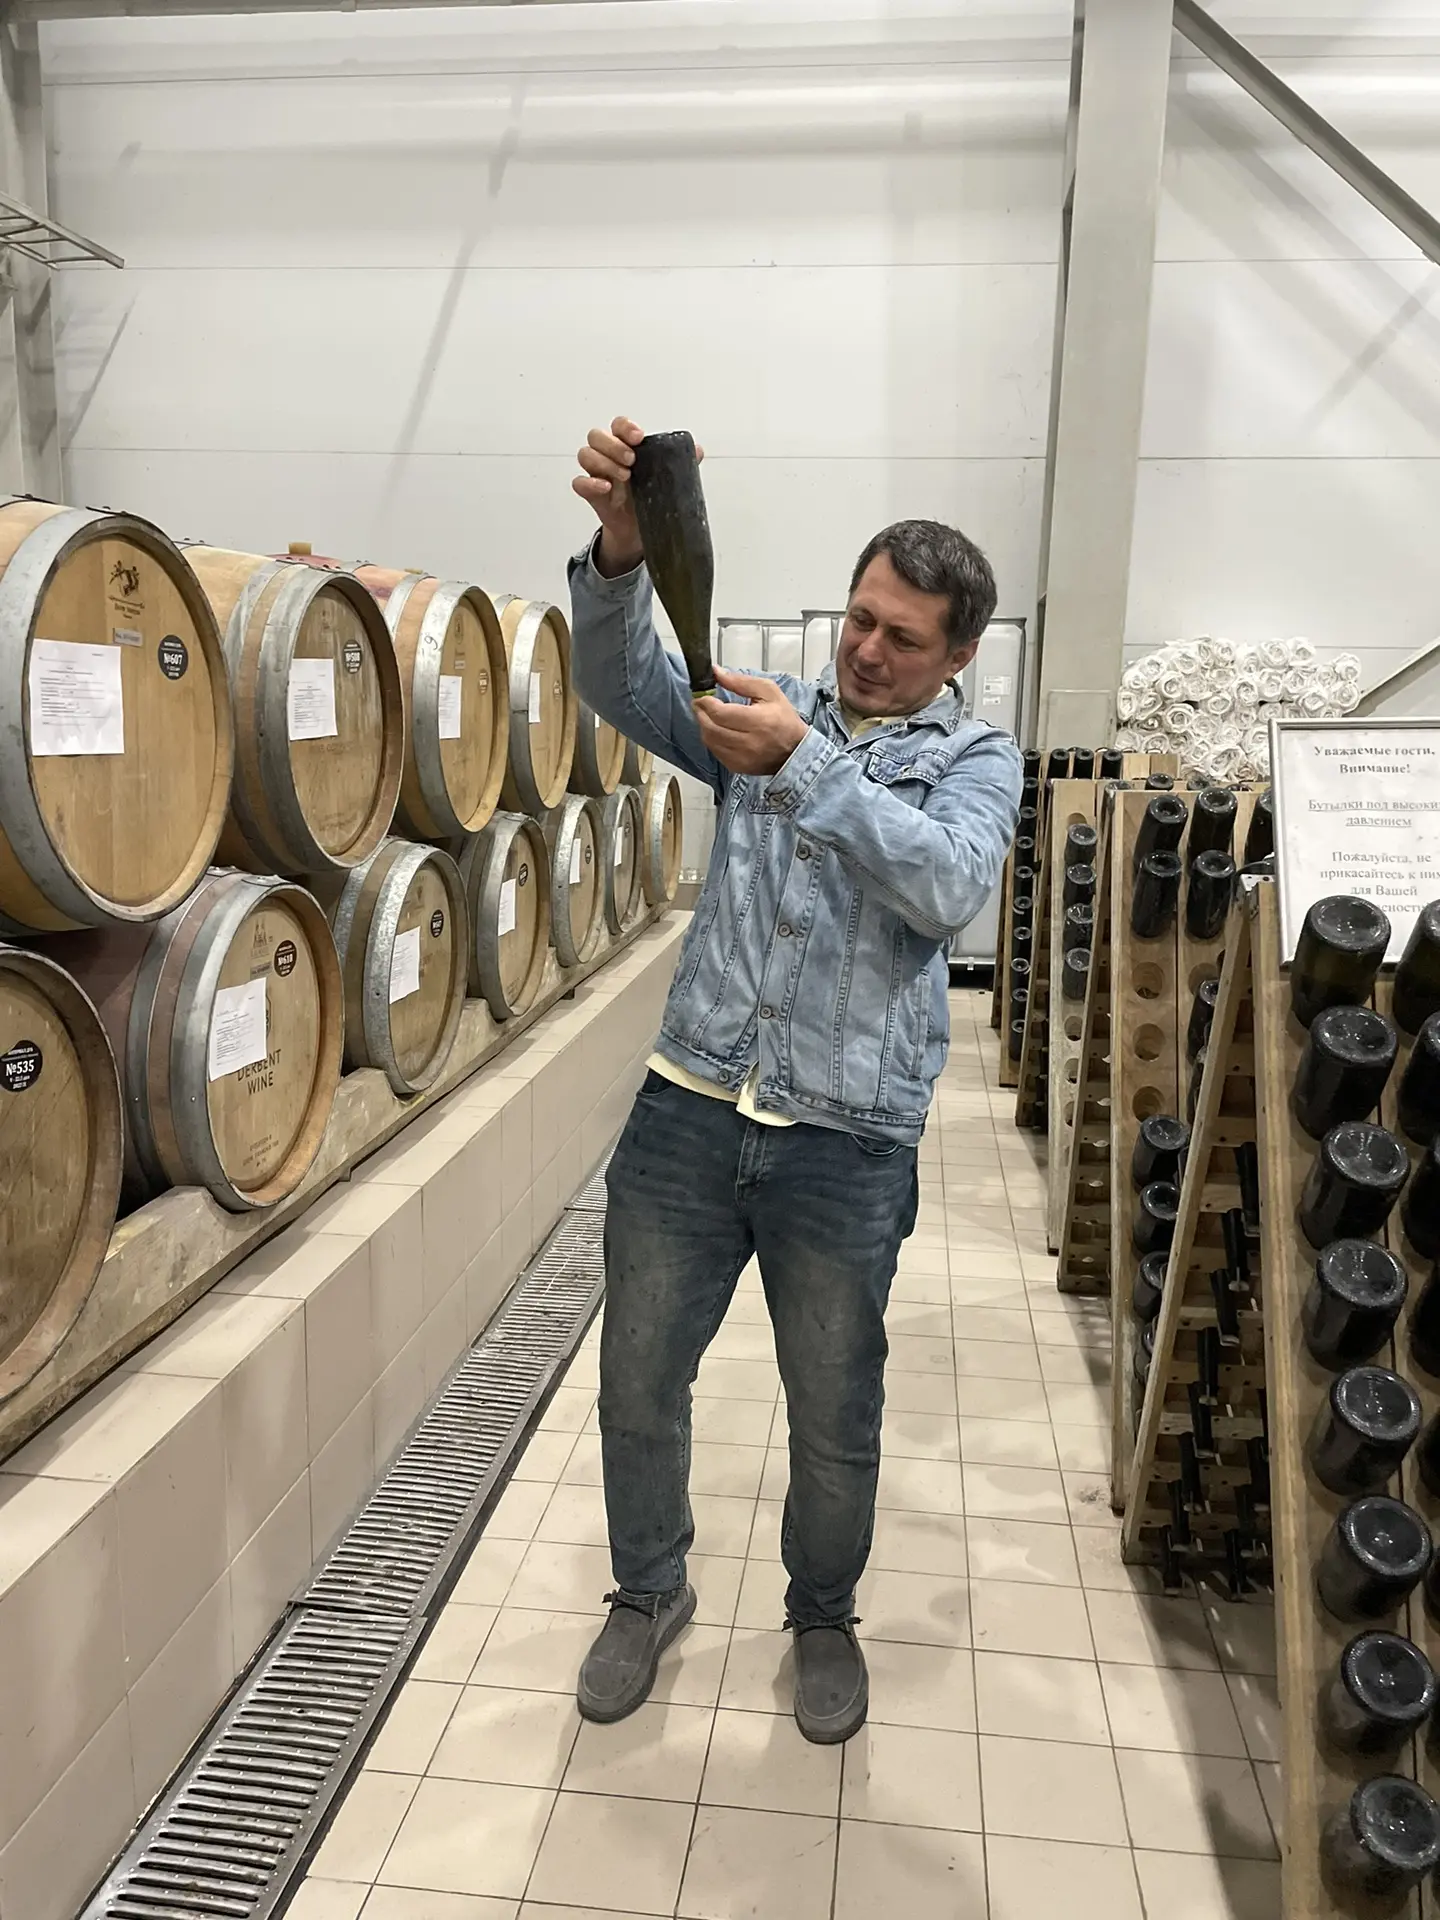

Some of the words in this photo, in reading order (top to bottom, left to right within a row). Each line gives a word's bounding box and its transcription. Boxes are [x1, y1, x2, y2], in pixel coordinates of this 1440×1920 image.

[1314, 745, 1391, 757] Уважаемые
[1395, 747, 1436, 757] гости,
[1339, 763, 1411, 774] Внимание!
[1308, 799, 1363, 811] Бутылки
[1366, 801, 1389, 810] под
[1392, 801, 1440, 810] высоки
[1345, 816, 1412, 828] давлением
[1332, 851, 1413, 865] Пожалуйста,
[1416, 854, 1432, 863] не
[1320, 868, 1405, 881] прикасайтесь
[1408, 870, 1416, 879] к
[1350, 886, 1372, 895] для
[1375, 884, 1418, 896] Вашей
[6, 1059, 35, 1077] №535
[247, 1071, 274, 1095] WINE
